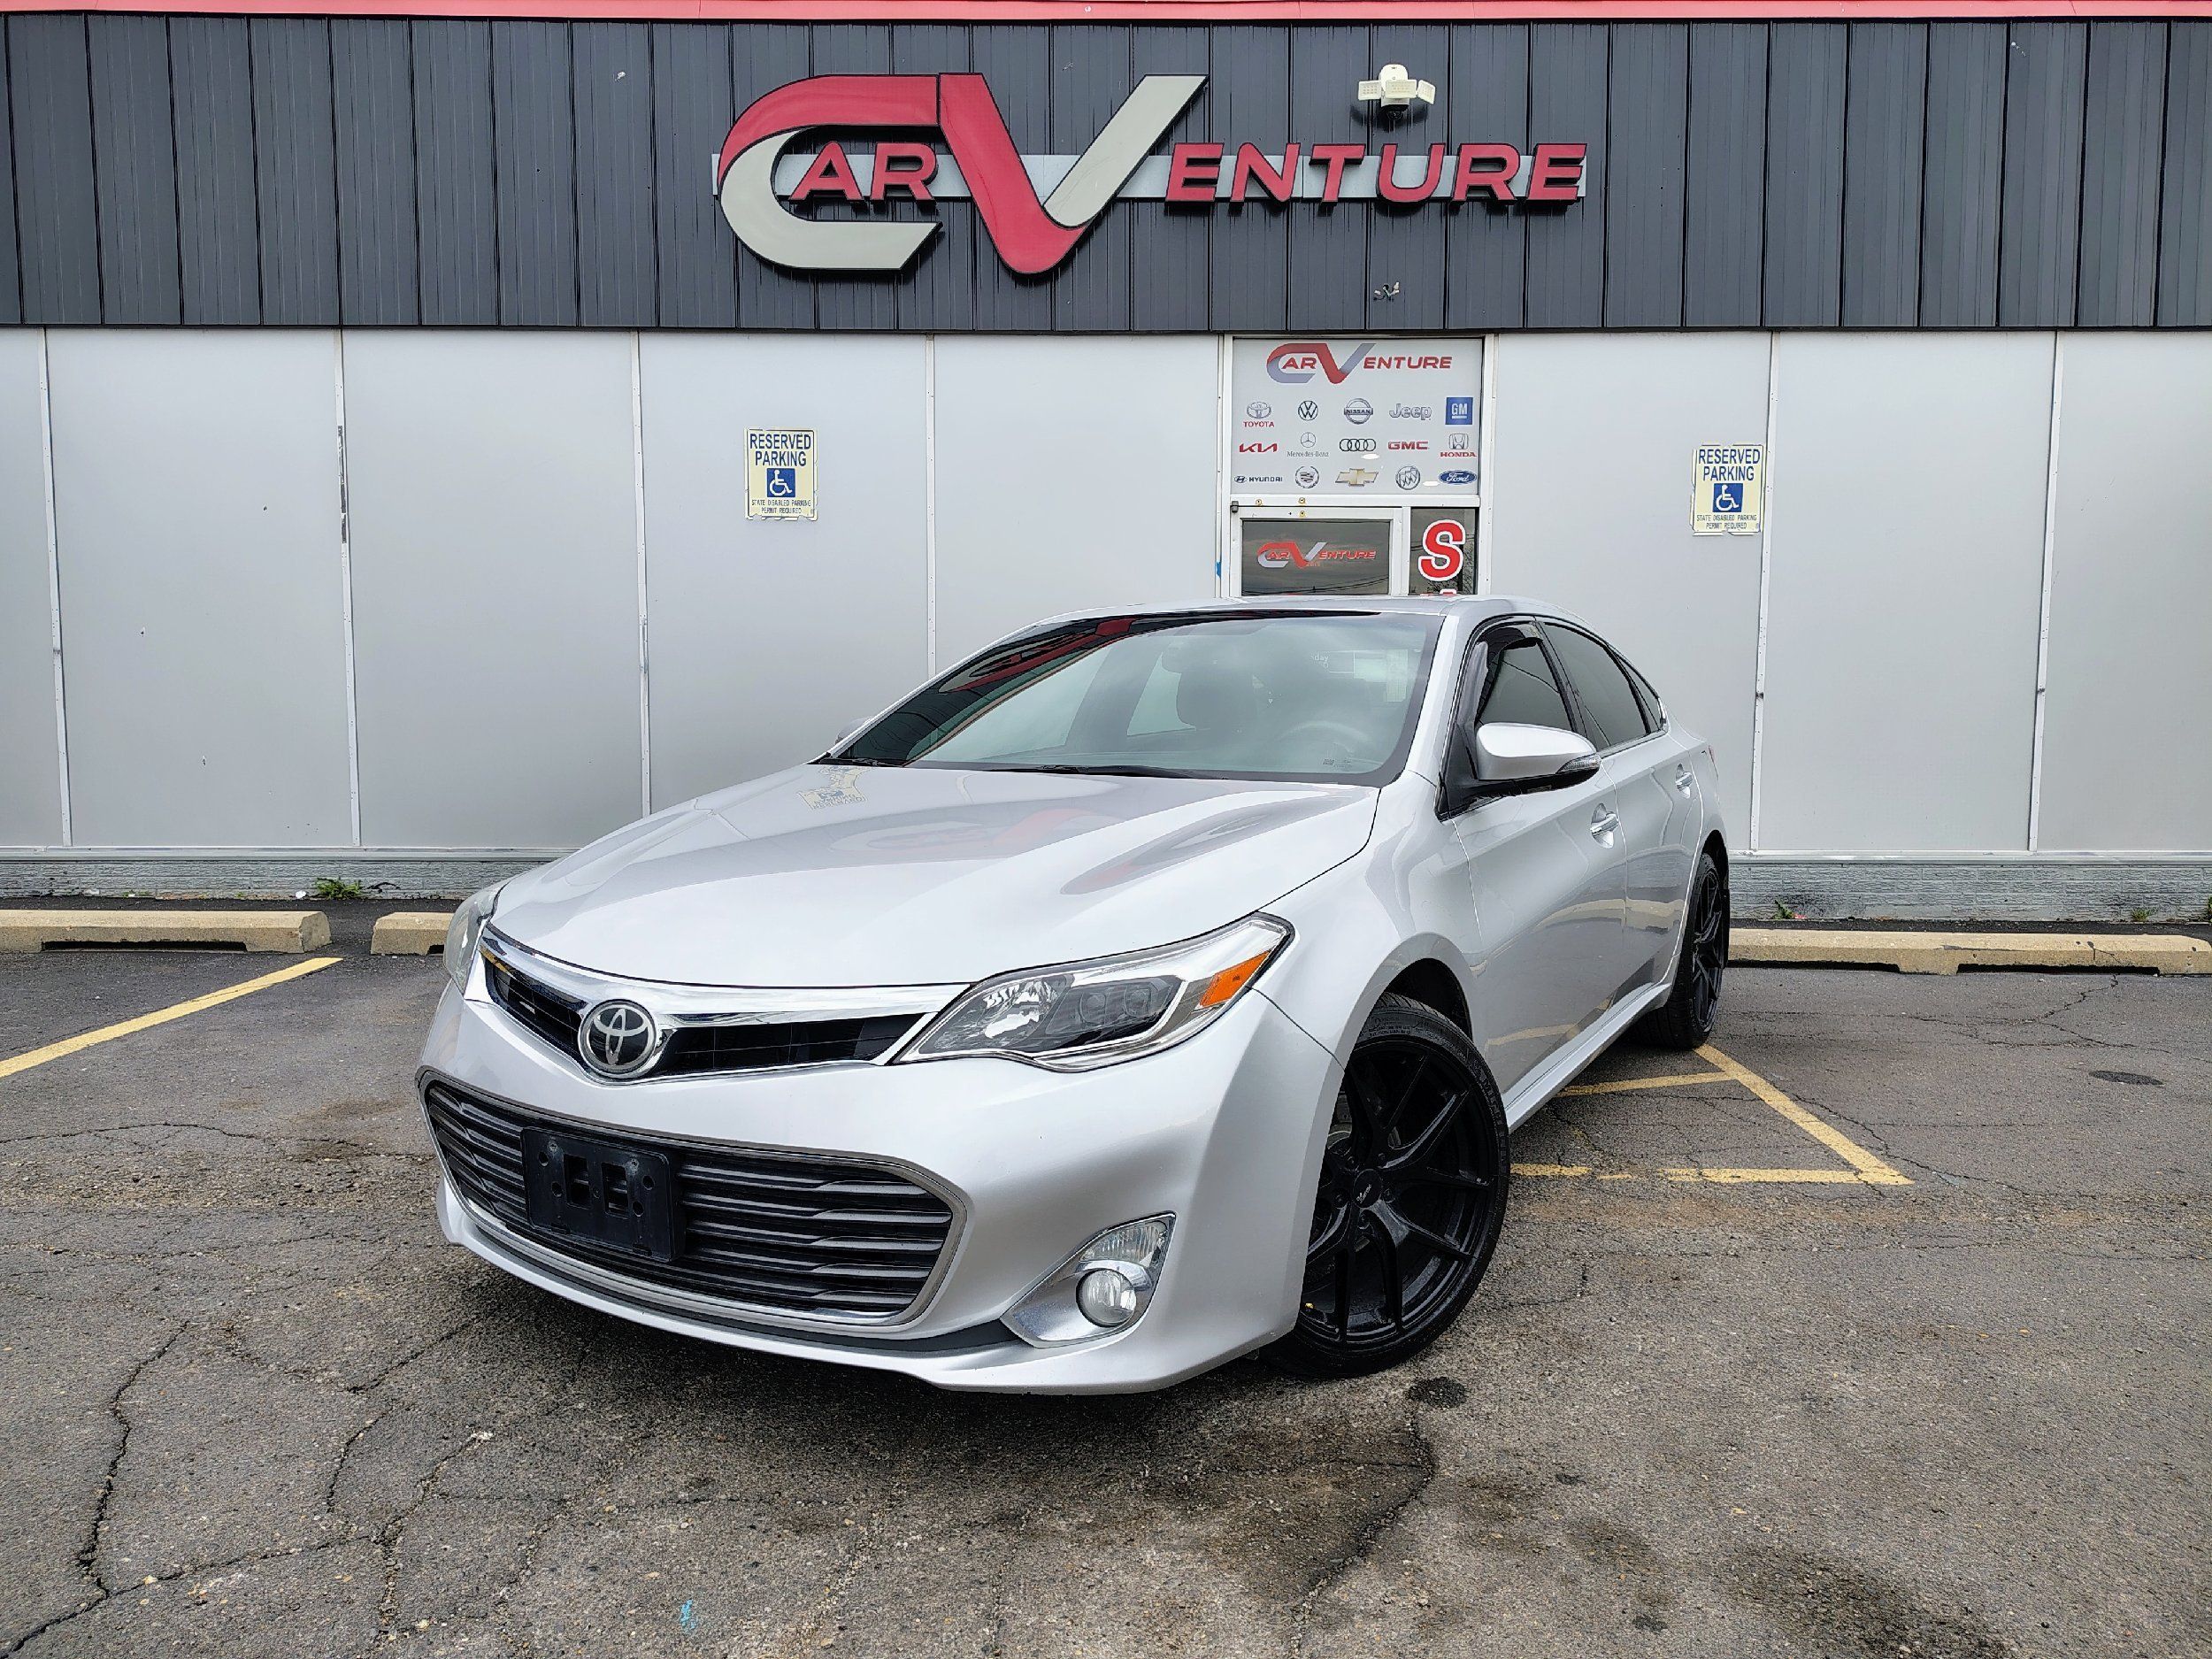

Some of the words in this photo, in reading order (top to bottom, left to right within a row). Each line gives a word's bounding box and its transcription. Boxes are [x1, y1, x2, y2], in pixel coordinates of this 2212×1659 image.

[1389, 403, 1432, 420] Jeep
[1451, 403, 1468, 416] GM
[749, 434, 811, 449] RESERVED
[1239, 443, 1278, 453] KIA
[1388, 442, 1429, 450] GMC
[755, 451, 807, 466] PARKING
[1698, 449, 1761, 465] RESERVED
[1446, 472, 1470, 483] Ford
[1703, 466, 1755, 481] PARKING
